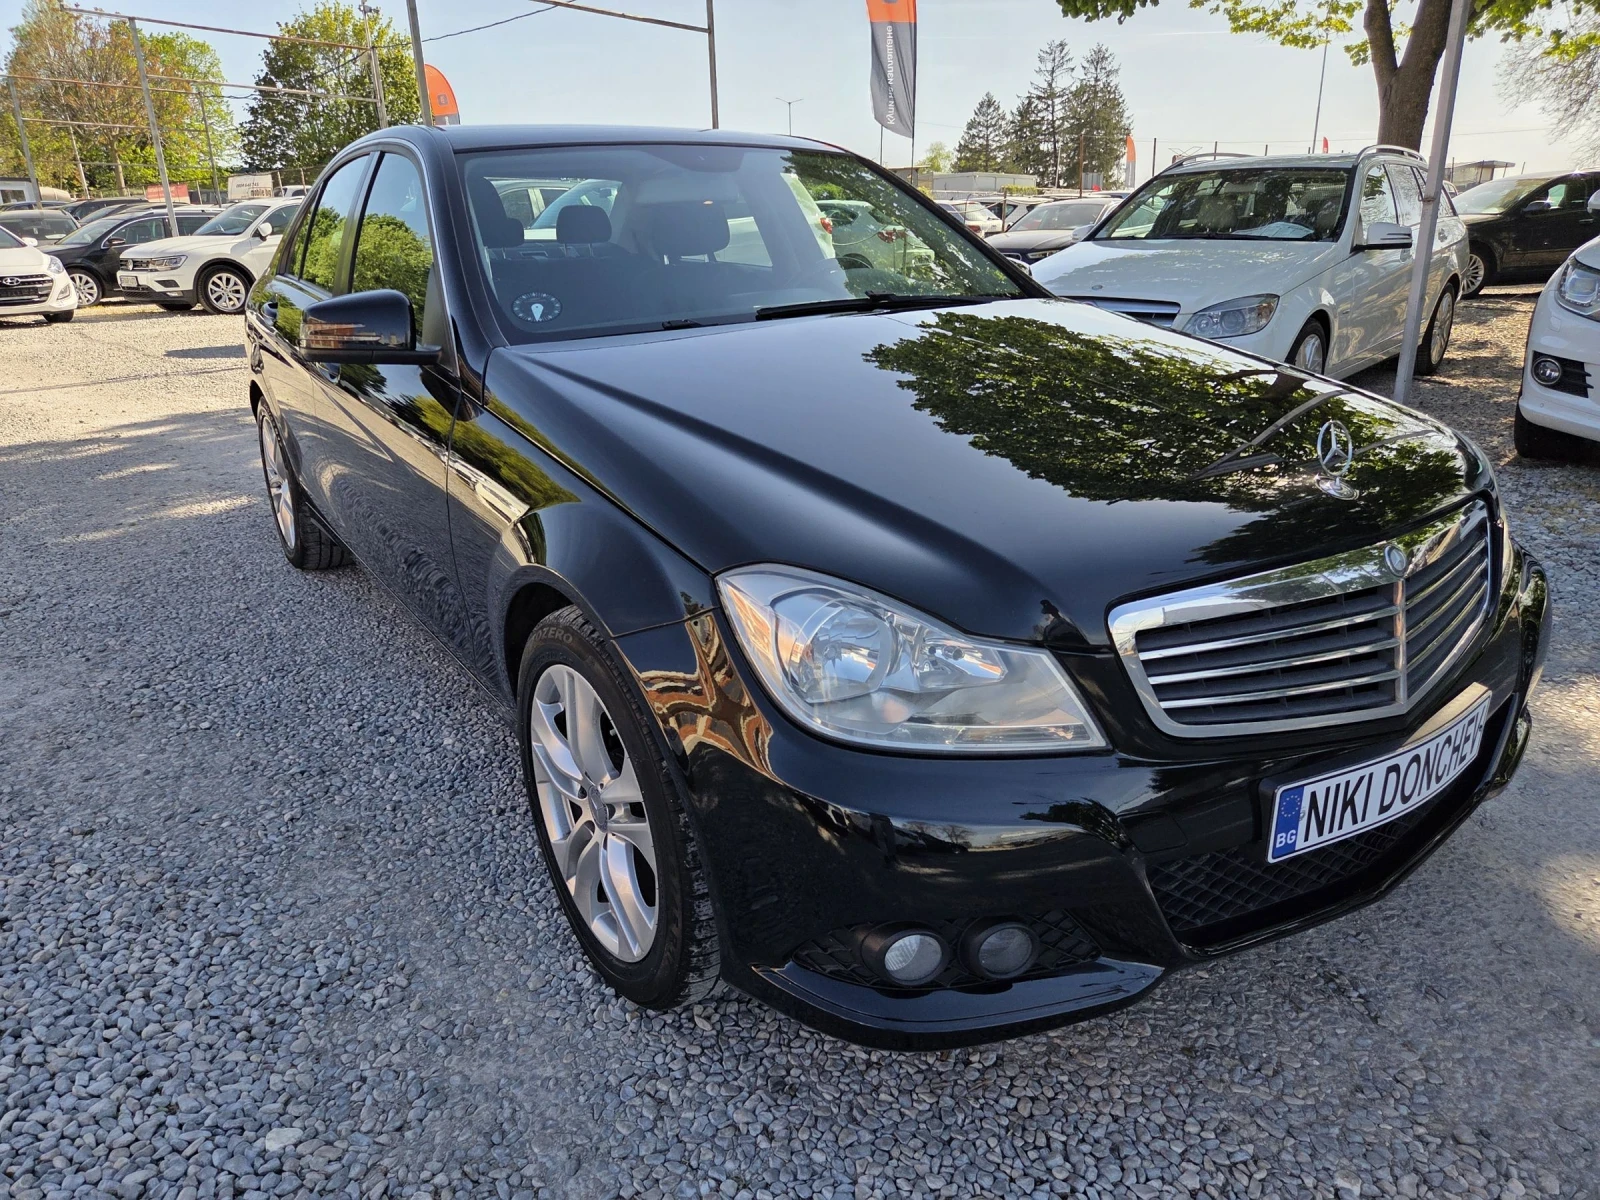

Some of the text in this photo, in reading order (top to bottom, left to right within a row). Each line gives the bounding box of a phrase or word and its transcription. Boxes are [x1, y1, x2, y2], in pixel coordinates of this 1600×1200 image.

[1304, 710, 1484, 843] NIKI DONCHEV
[1275, 829, 1297, 848] BG
